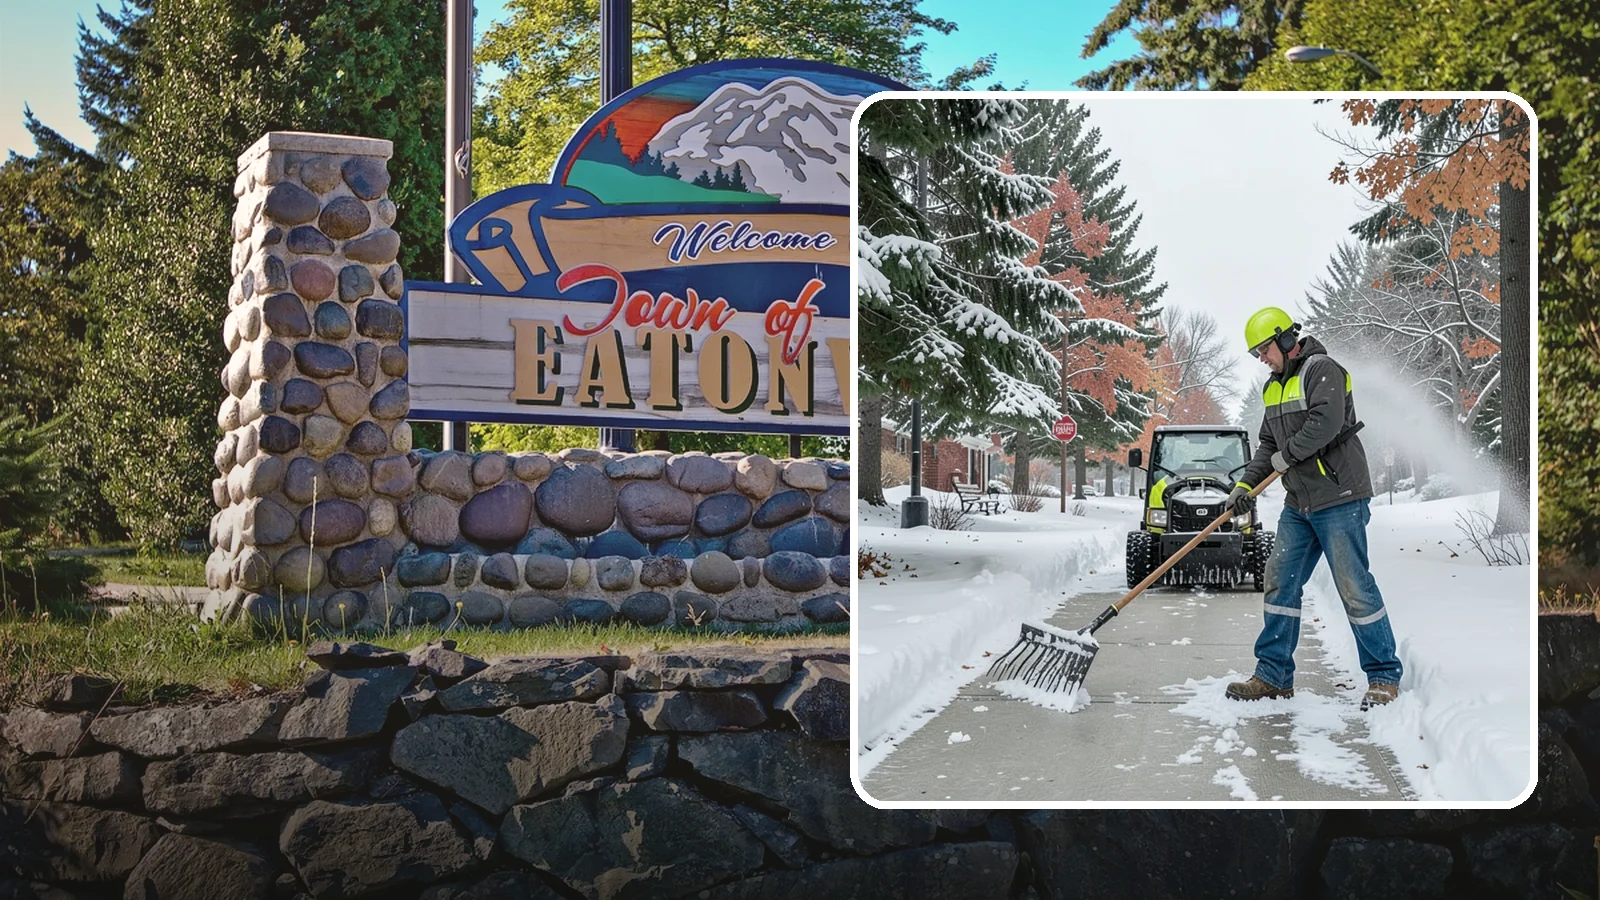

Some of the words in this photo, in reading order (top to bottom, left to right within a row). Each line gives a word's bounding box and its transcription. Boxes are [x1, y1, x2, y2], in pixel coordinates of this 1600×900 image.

[653, 220, 837, 263] Welcome
[556, 263, 737, 336] Town
[765, 279, 825, 365] of
